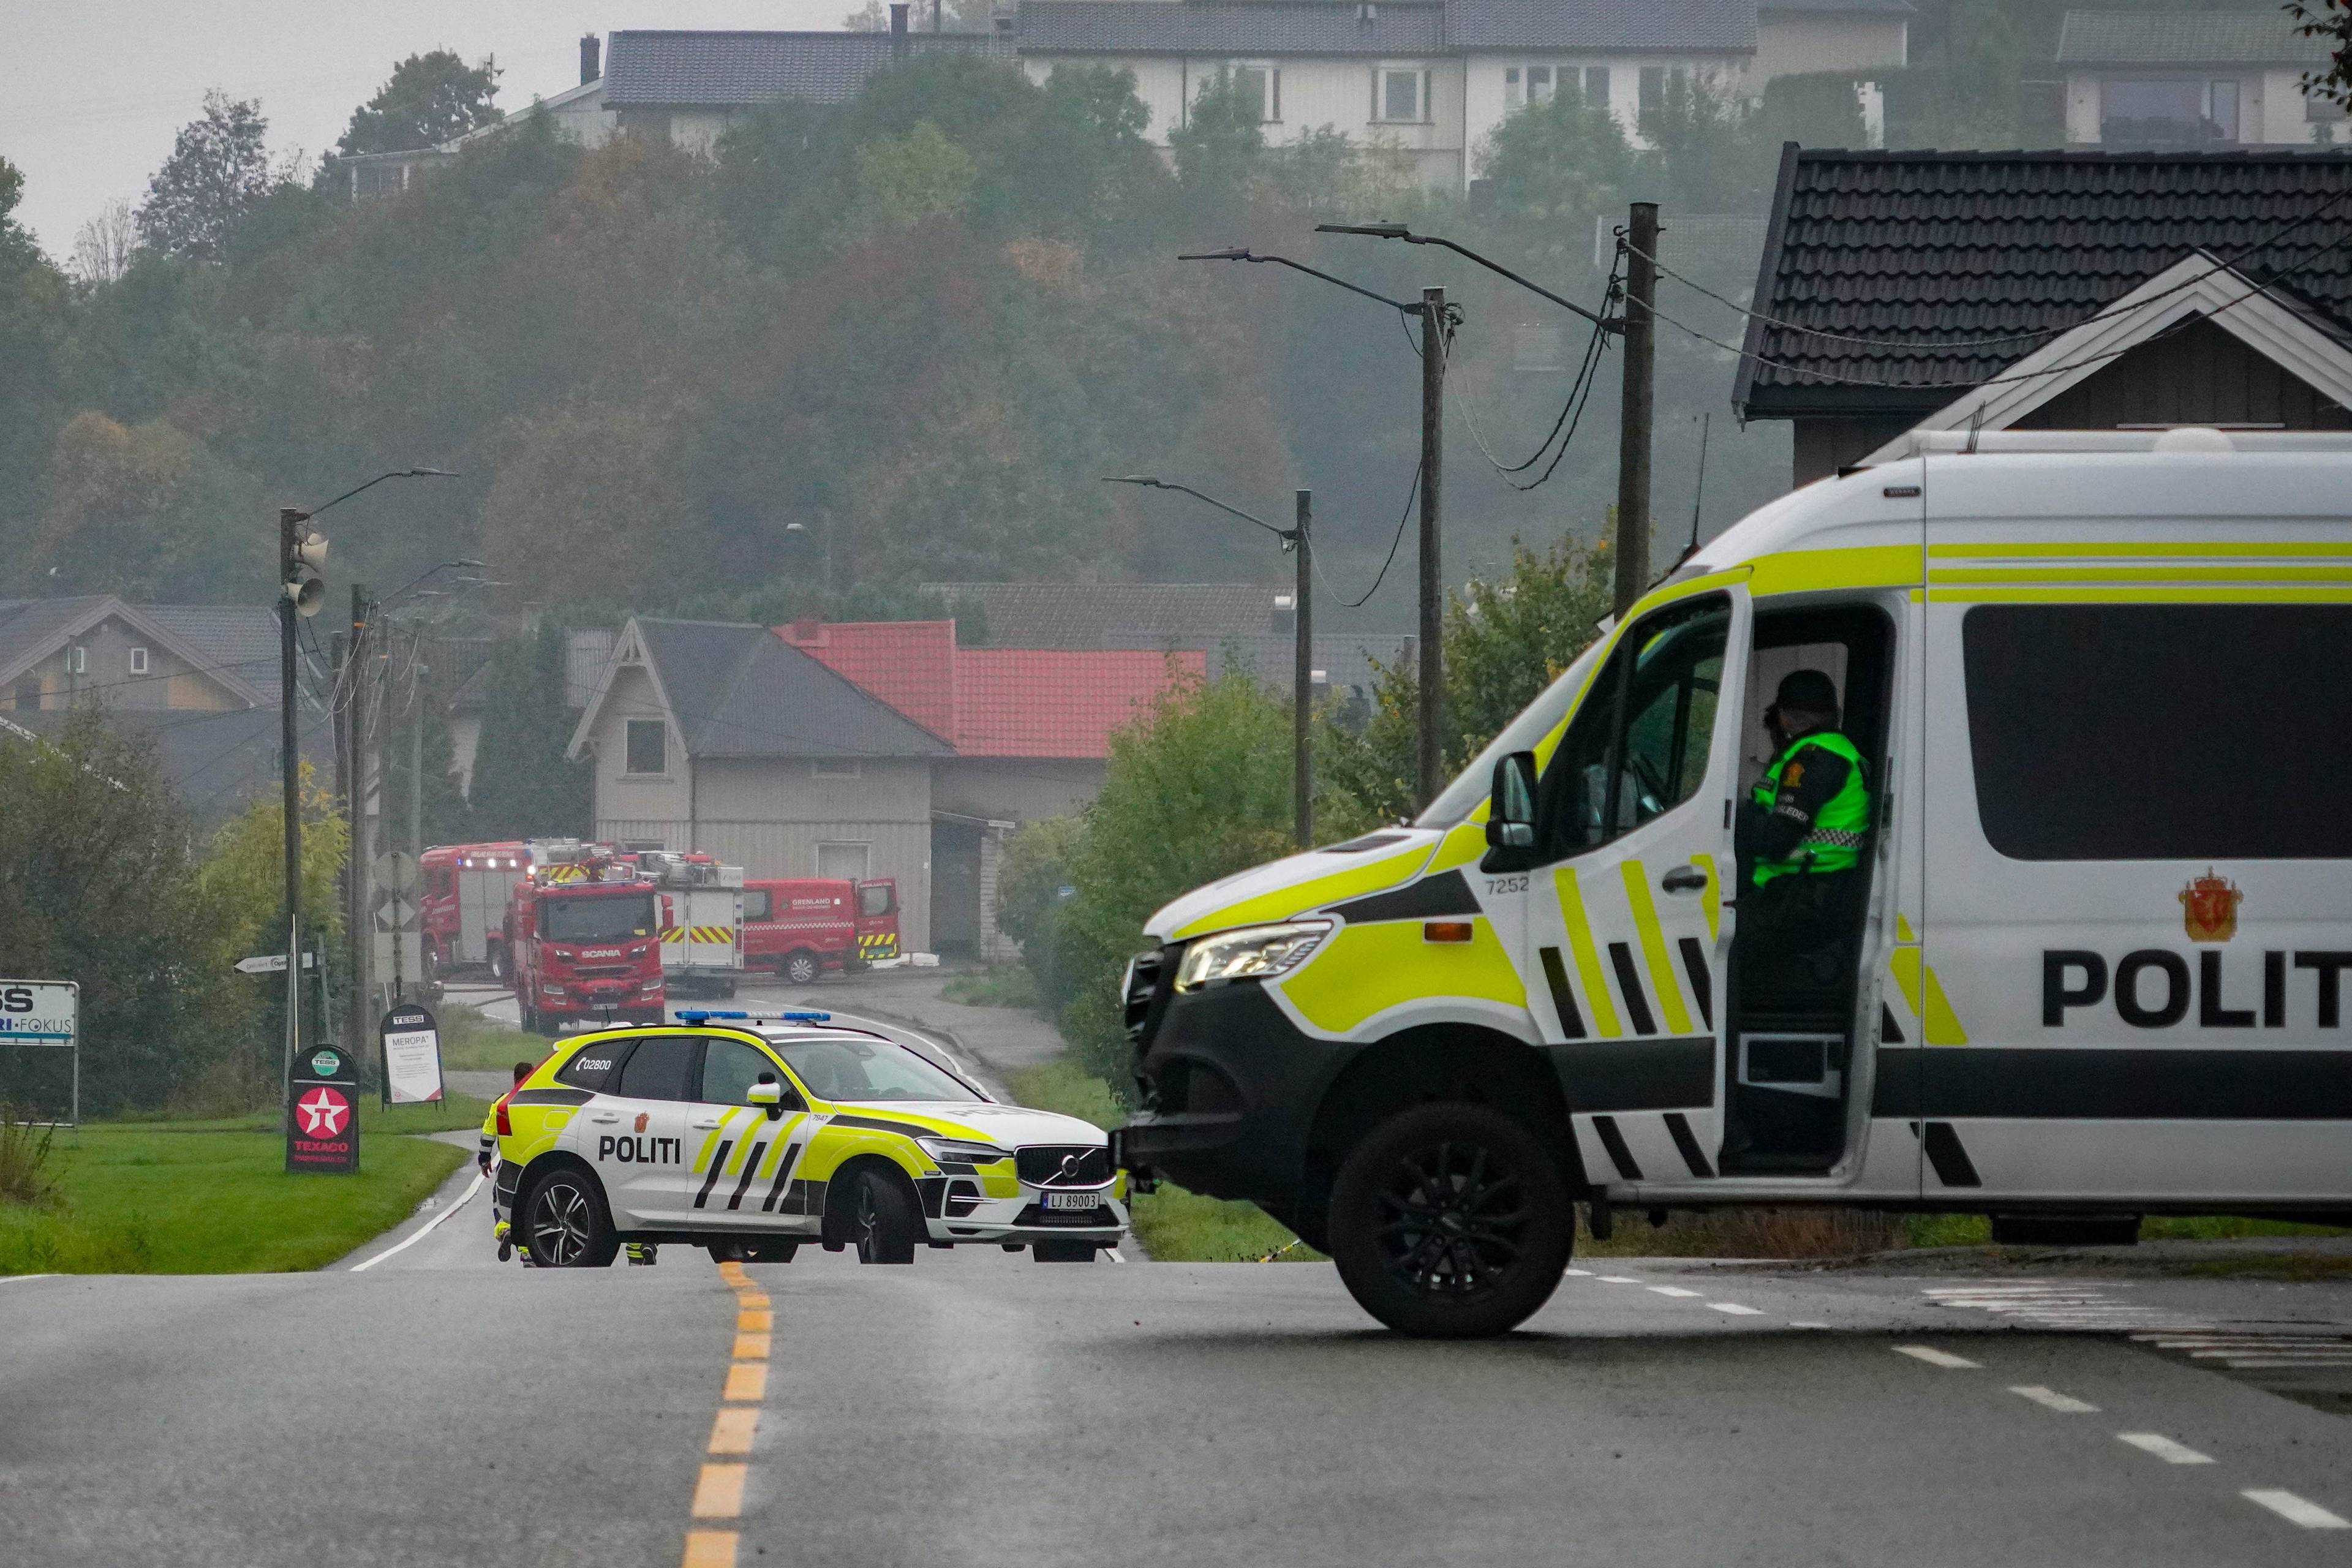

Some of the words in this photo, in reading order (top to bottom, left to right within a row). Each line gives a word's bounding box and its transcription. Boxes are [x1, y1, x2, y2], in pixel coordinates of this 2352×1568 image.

[1485, 877, 1529, 895] 7252
[581, 949, 621, 958] SCANIA
[20, 1019, 72, 1033] FOKUS
[584, 1060, 612, 1070] 02800
[294, 1140, 349, 1153] TEXACO
[598, 1136, 680, 1164] POLITI
[1066, 1196, 1096, 1207] 89003
